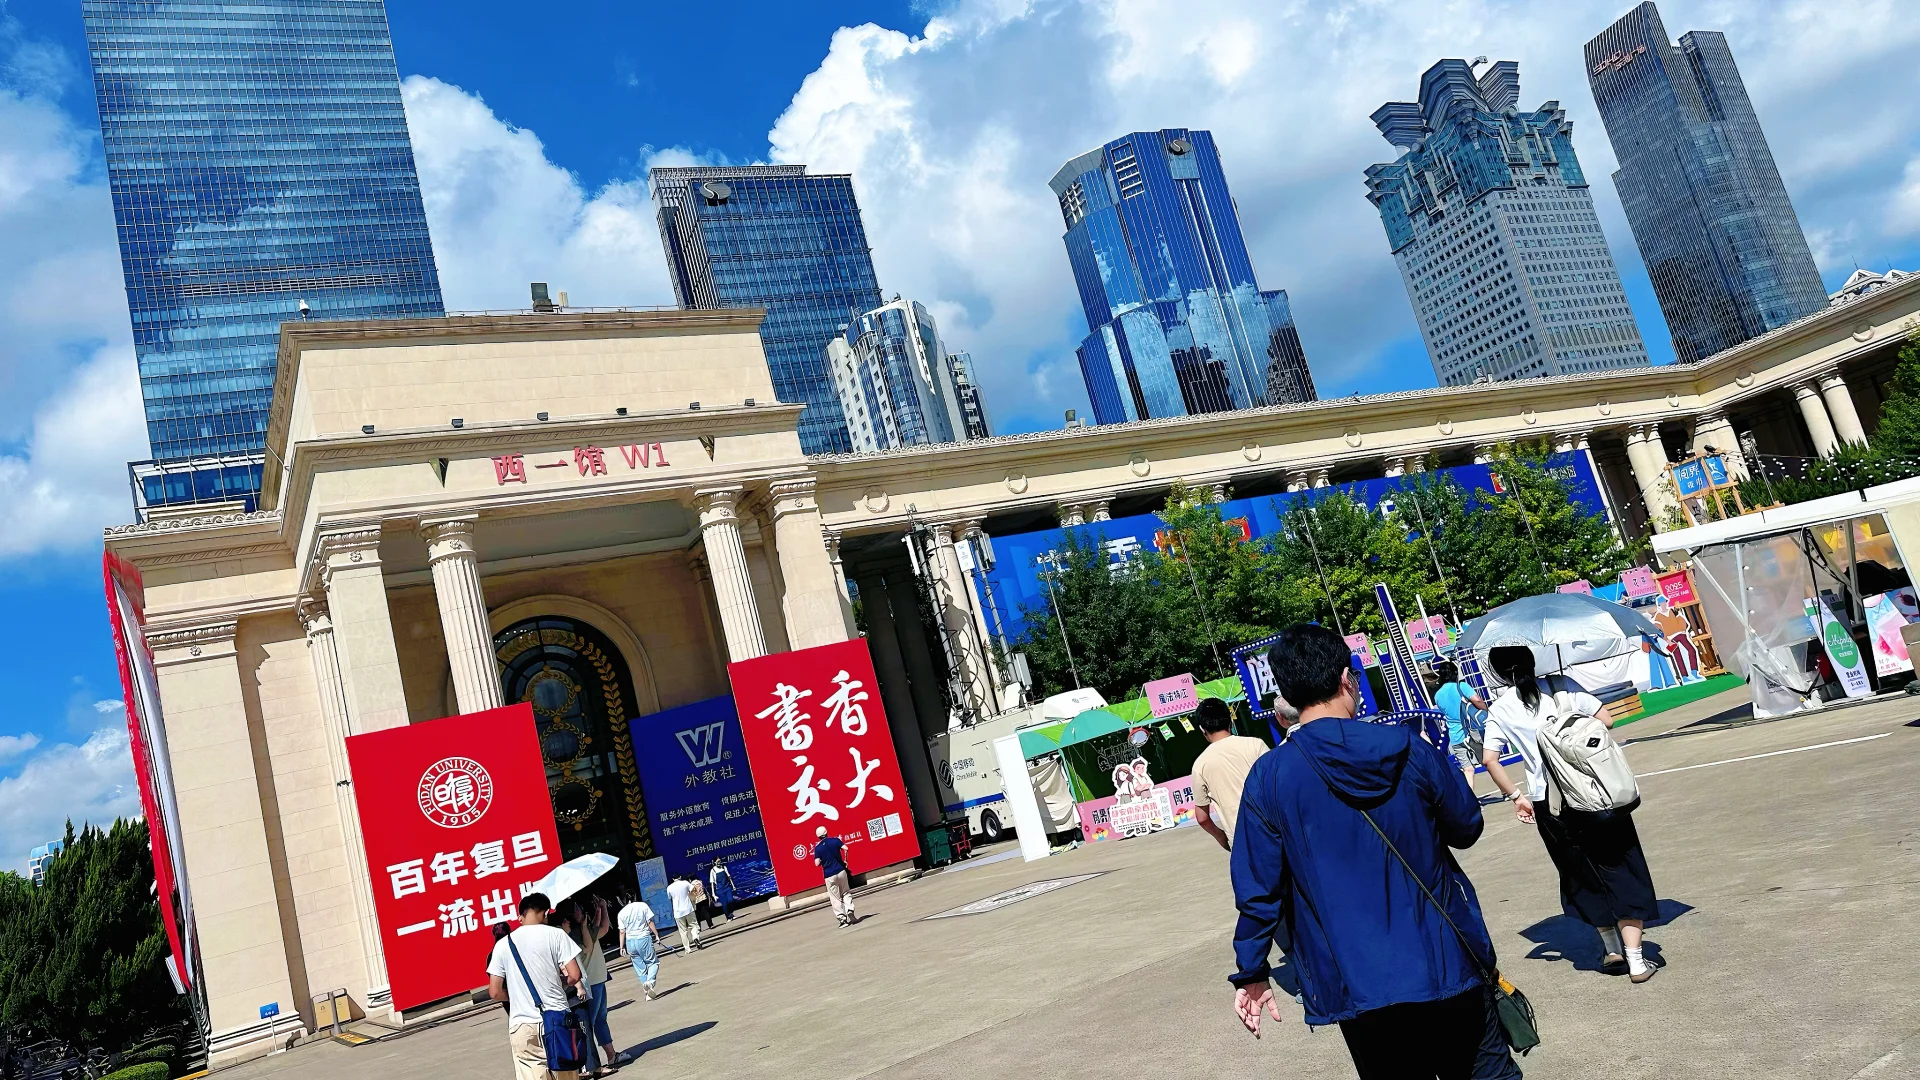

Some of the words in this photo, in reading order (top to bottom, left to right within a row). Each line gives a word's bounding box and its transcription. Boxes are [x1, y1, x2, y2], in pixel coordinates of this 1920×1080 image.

[490, 445, 608, 486] 西一馆
[619, 442, 671, 469] W1
[420, 772, 436, 816] FUDAN
[434, 759, 491, 803] UNIVERSITY
[684, 764, 736, 789] 外教社
[440, 806, 481, 826] 1905
[659, 801, 711, 823] 服务外语教育
[721, 789, 757, 806] 传播先进
[724, 803, 760, 821] 促进人才
[386, 830, 549, 900] 百年复旦
[696, 848, 758, 871] 西一二楼W2-12
